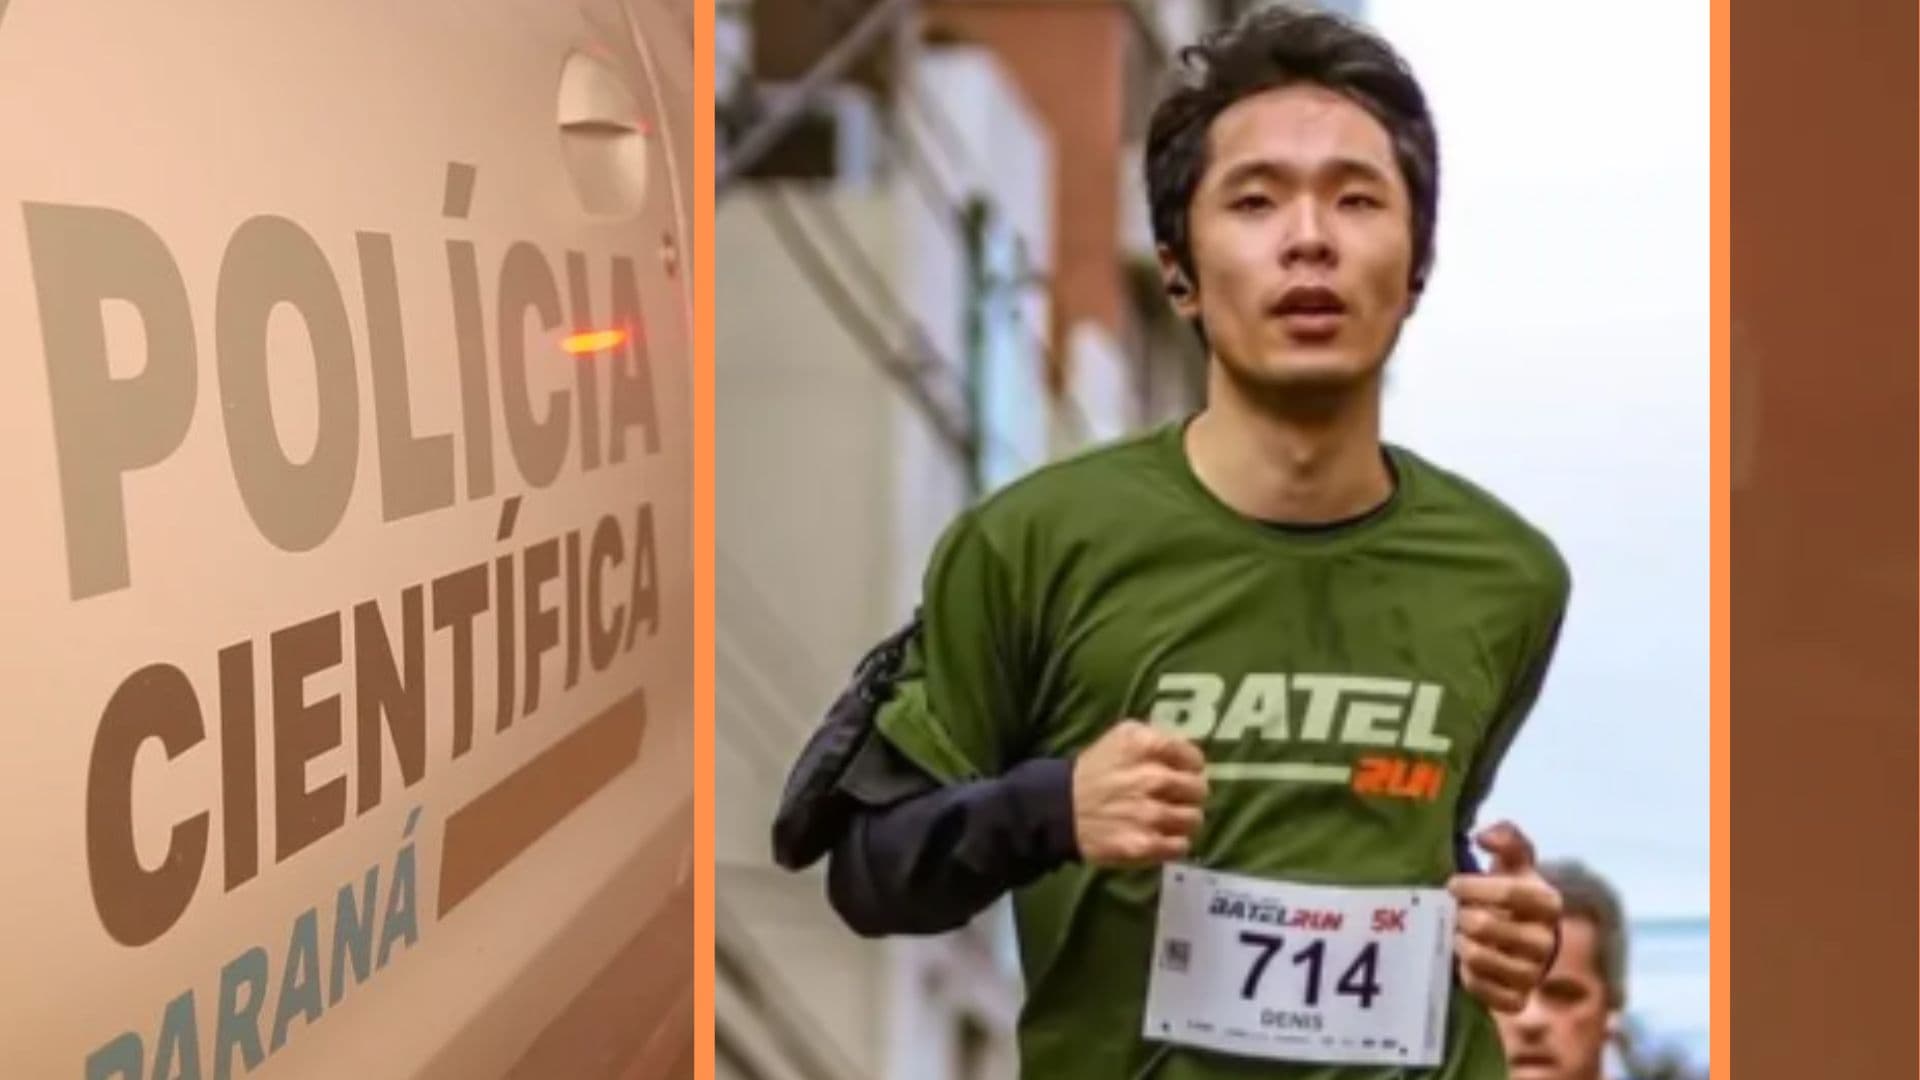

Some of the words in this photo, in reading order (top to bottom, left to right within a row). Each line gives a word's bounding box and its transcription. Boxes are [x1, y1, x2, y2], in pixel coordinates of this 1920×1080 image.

[21, 161, 660, 602] POLÍCIA
[86, 495, 660, 947] CIENTÍFICA
[1152, 672, 1452, 752] BATEL
[1353, 757, 1446, 799] RUN
[1371, 908, 1408, 932] 5K
[1238, 932, 1382, 1009] 714
[1260, 1009, 1323, 1031] DENIS
